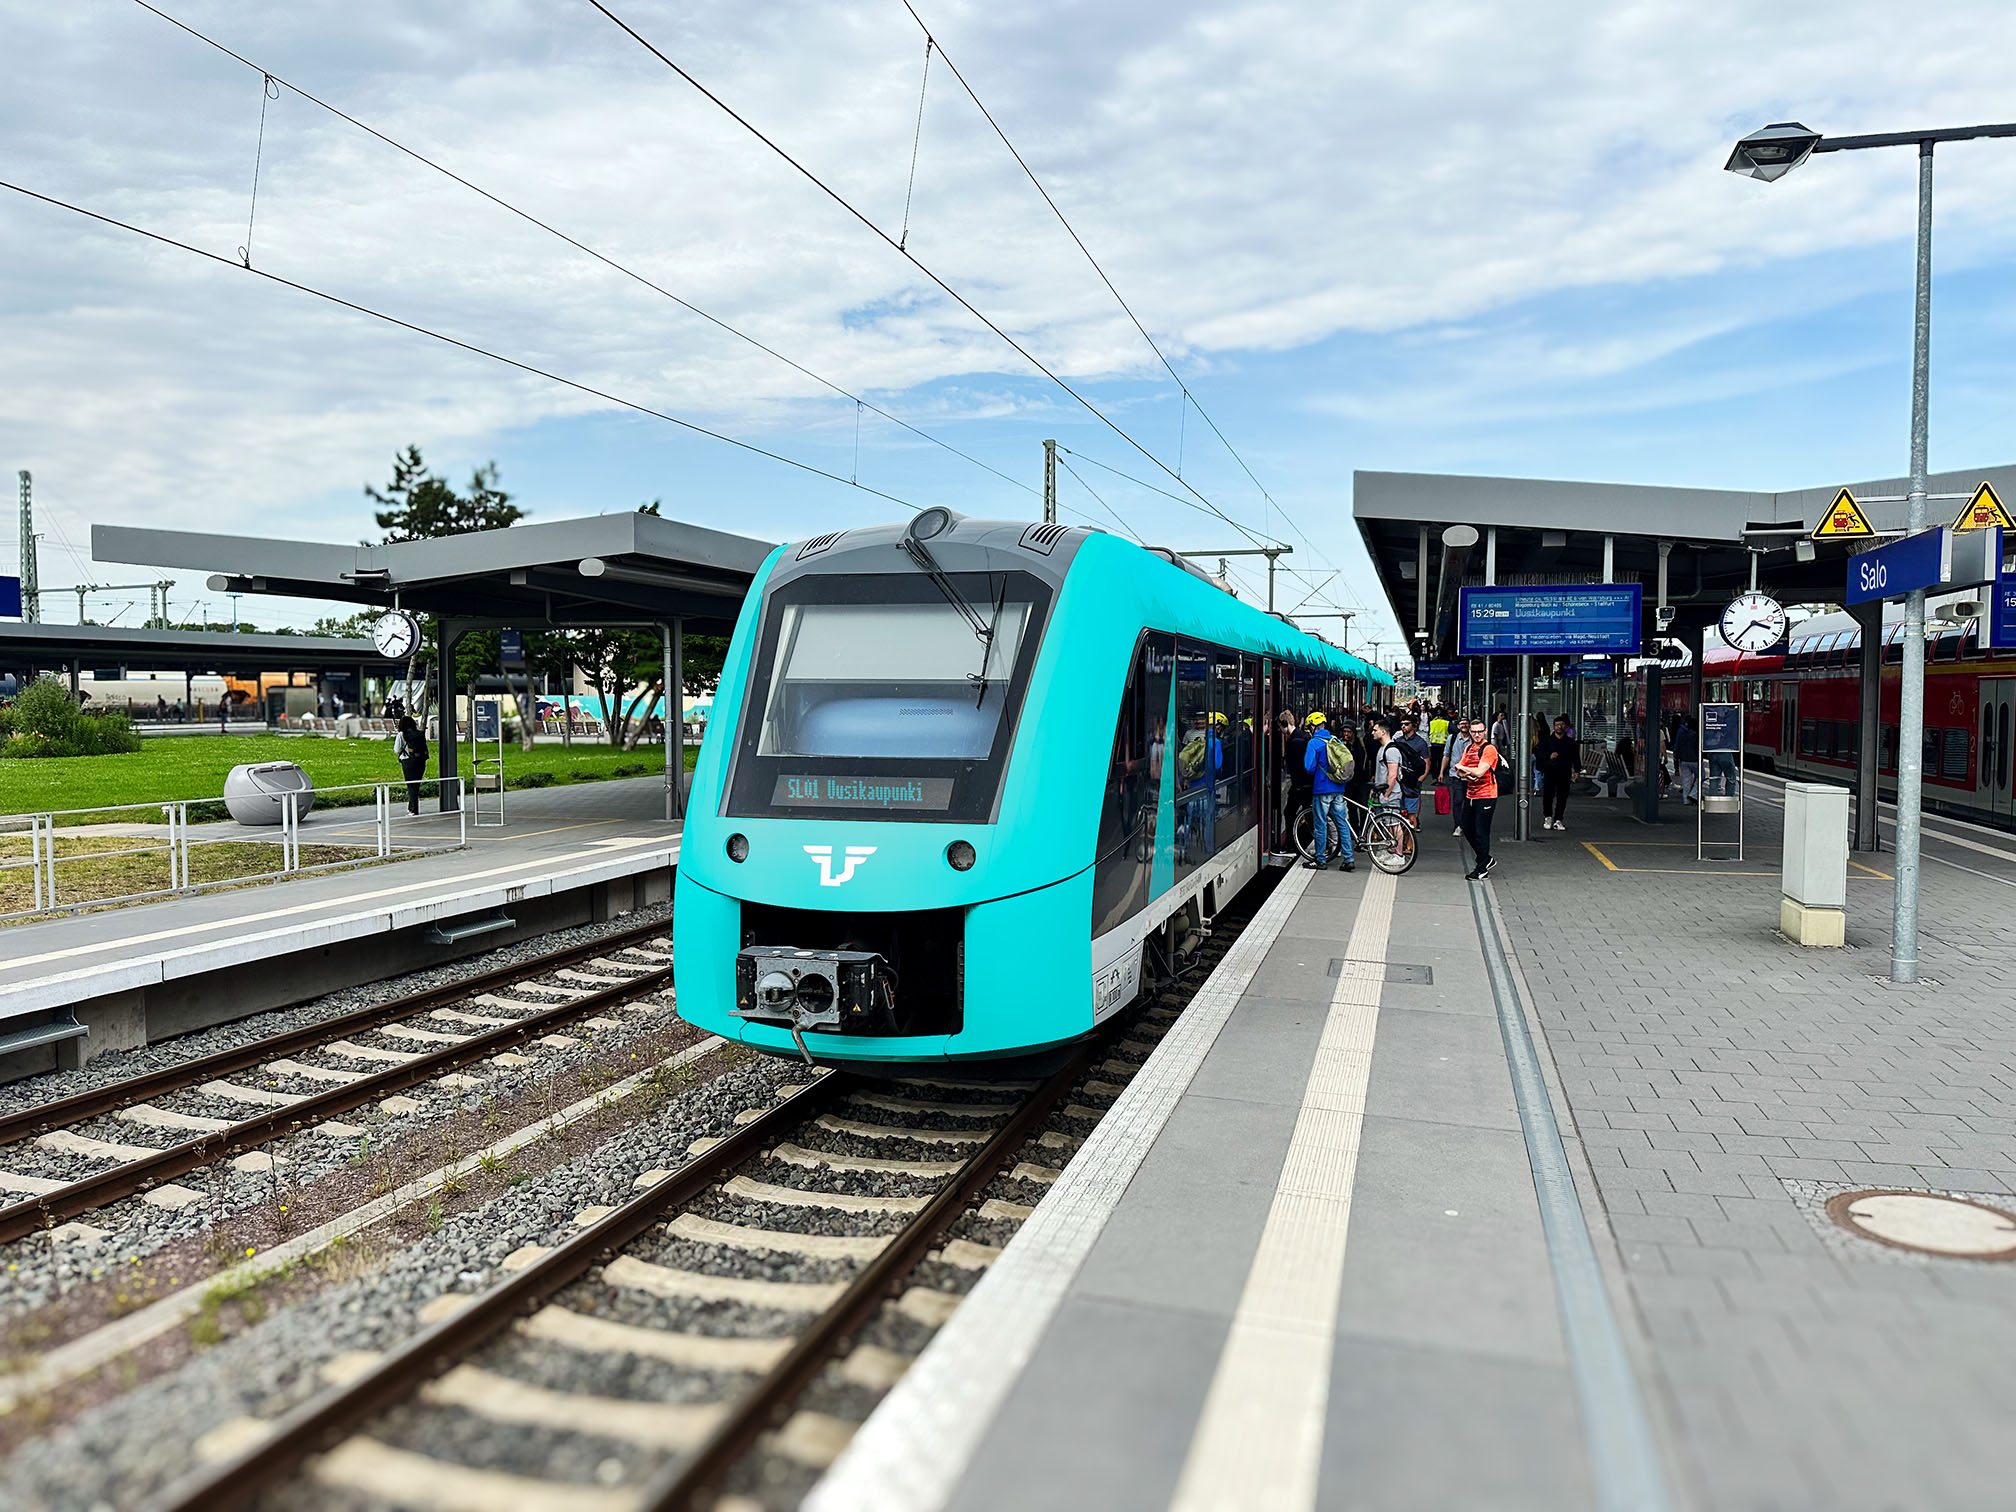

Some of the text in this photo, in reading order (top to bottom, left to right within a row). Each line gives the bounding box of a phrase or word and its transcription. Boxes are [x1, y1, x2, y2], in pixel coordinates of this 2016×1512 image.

[1860, 559, 1887, 591] Salo
[1515, 608, 1575, 619] Uusikaupunki
[1649, 642, 1659, 656] 3
[1972, 707, 1976, 724] 1
[1970, 736, 1976, 753] 2
[827, 779, 923, 806] Uusikaupunki
